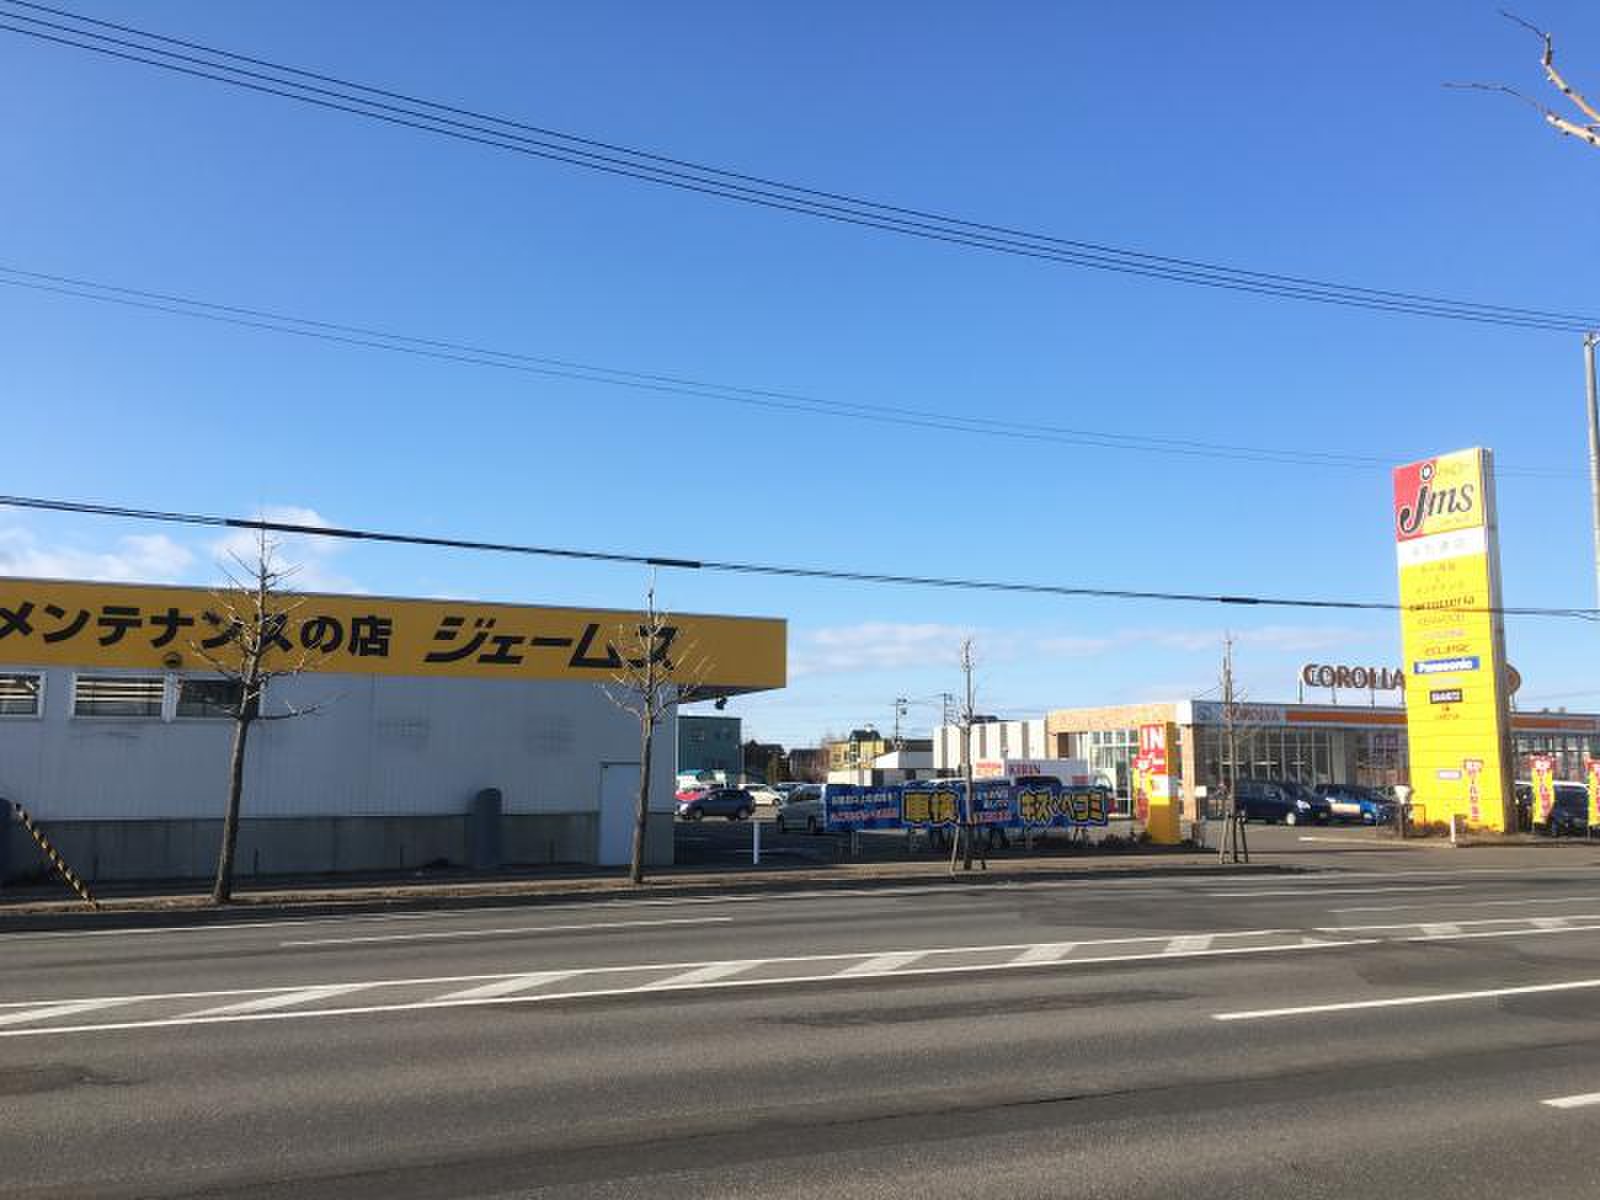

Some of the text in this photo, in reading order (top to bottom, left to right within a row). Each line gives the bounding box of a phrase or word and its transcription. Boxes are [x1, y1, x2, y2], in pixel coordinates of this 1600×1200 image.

[1400, 464, 1474, 533] jms
[0, 602, 678, 671] メンテナンスの店 ジェームス
[1303, 664, 1406, 690] COROLLA
[1141, 726, 1164, 751] IN
